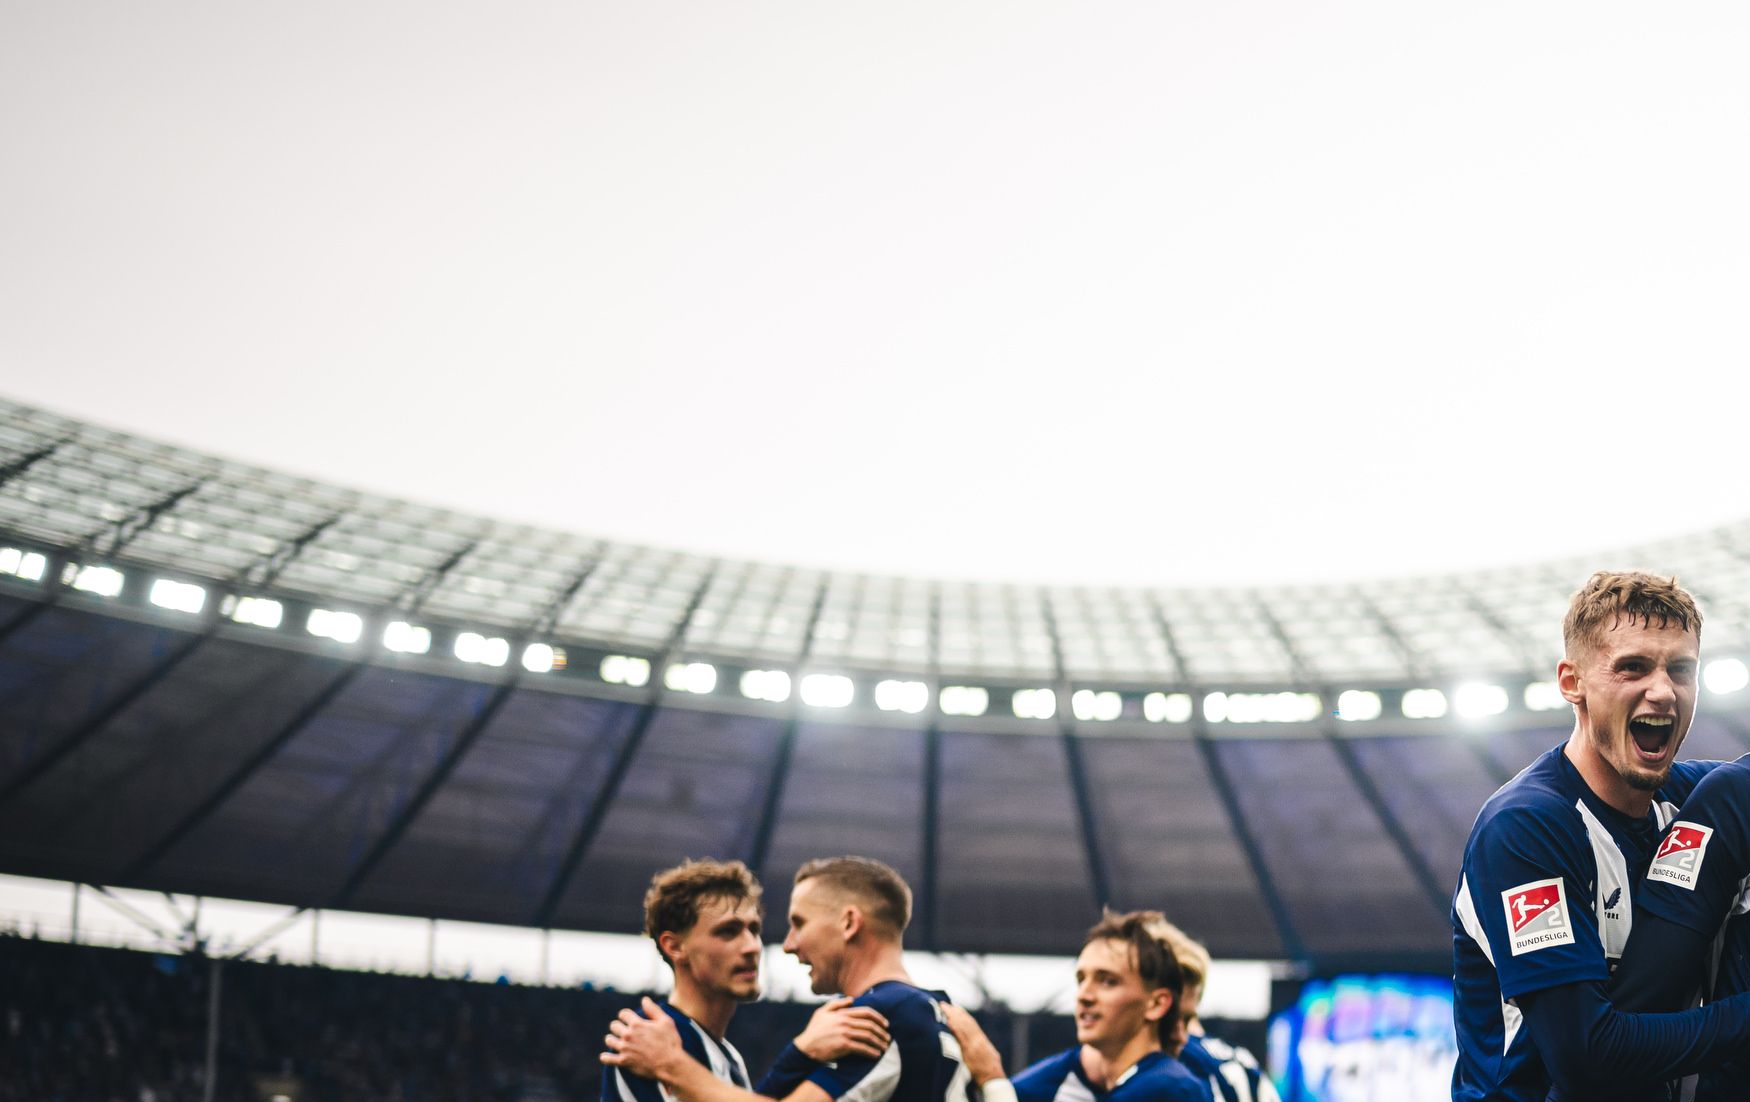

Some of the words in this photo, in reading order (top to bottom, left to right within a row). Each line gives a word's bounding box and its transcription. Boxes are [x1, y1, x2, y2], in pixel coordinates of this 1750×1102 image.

[1679, 849, 1695, 869] 2
[1651, 867, 1691, 884] BUNDESLIGA
[1546, 906, 1563, 926] 2
[1516, 931, 1569, 949] BUNDESLIGA
